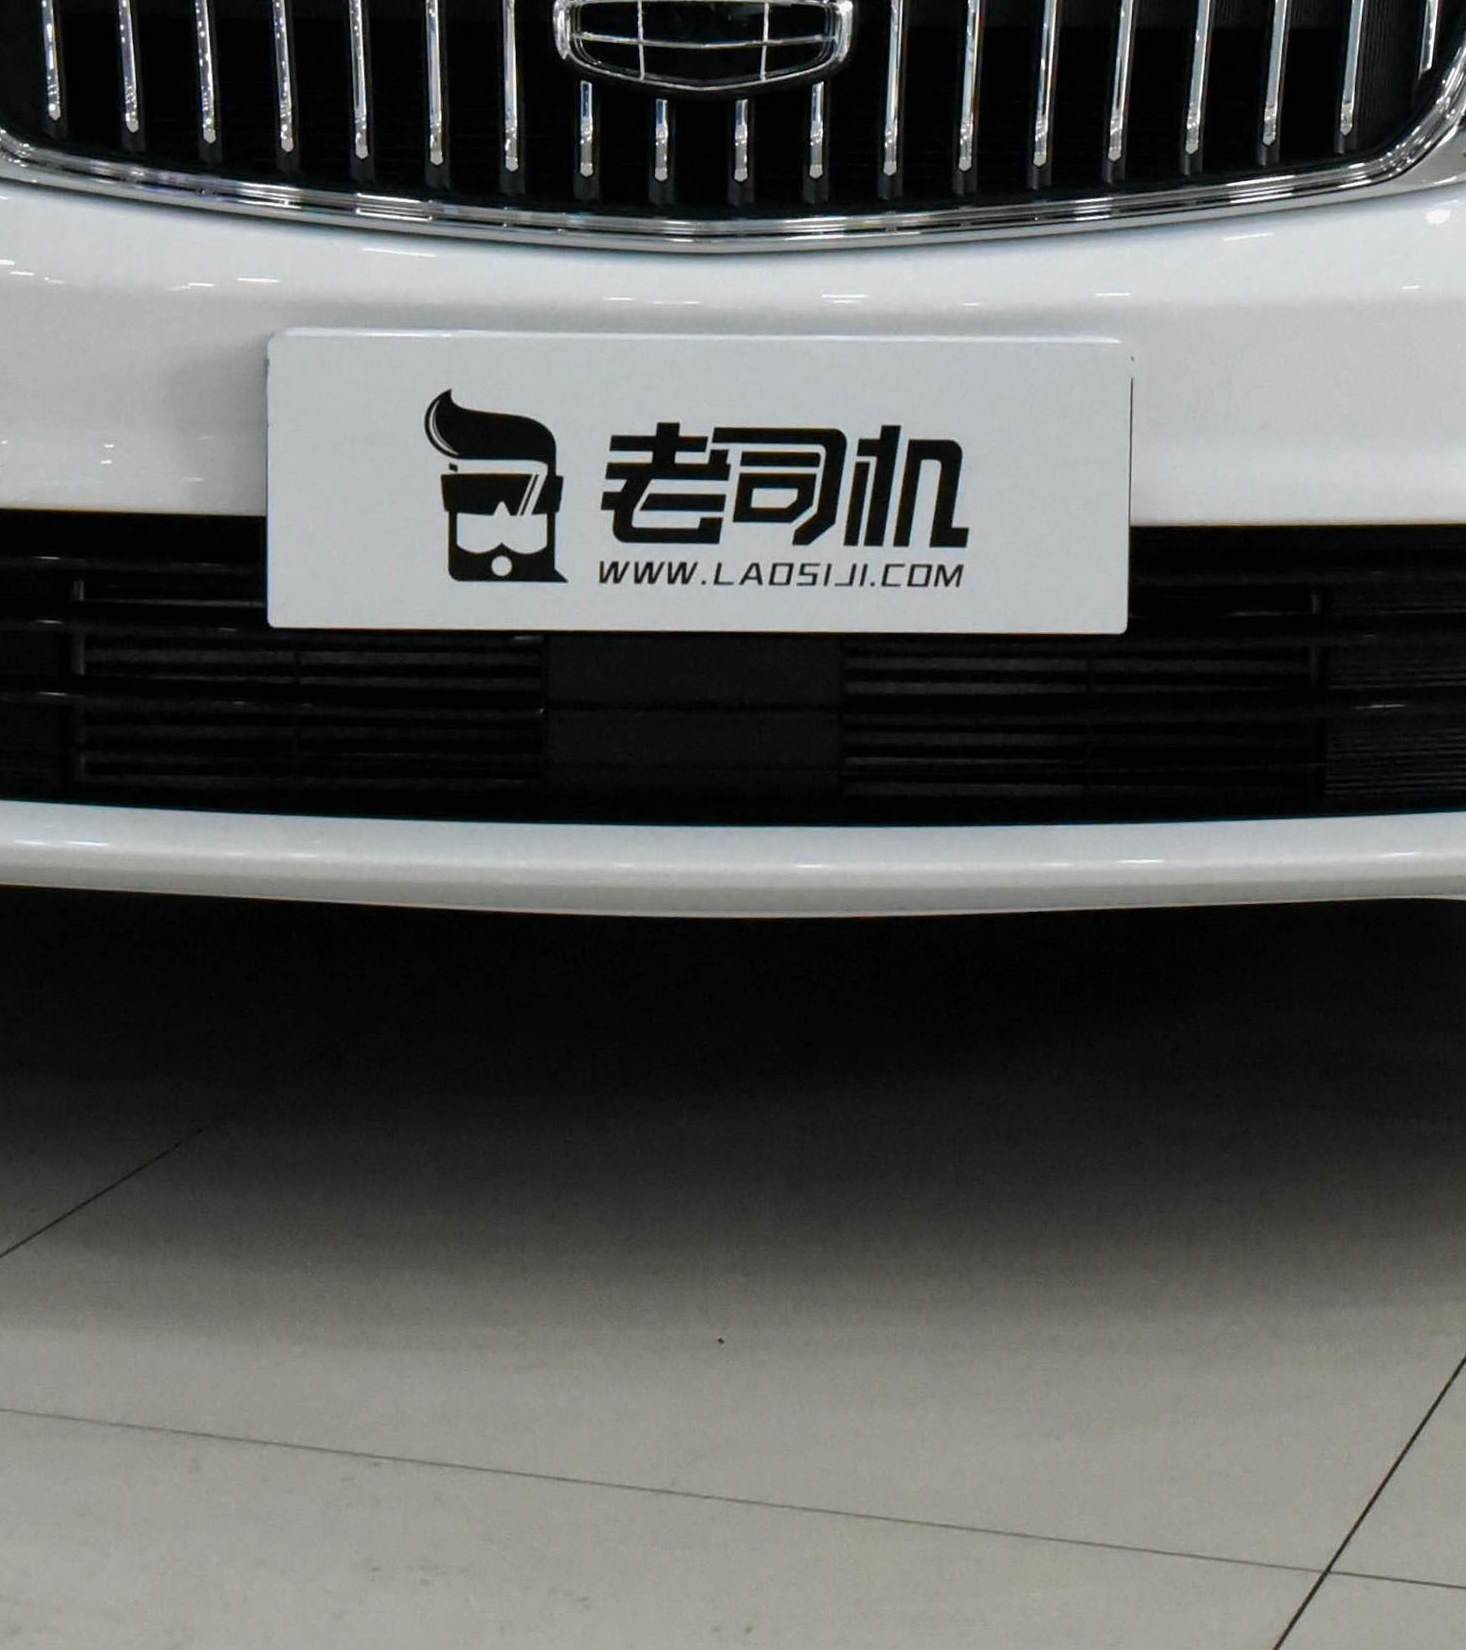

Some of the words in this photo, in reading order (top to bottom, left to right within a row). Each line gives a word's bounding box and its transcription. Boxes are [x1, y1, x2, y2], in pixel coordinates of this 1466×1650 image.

[600, 421, 970, 550] 老司机
[597, 560, 966, 590] WWW.LAOSIJI.COM
